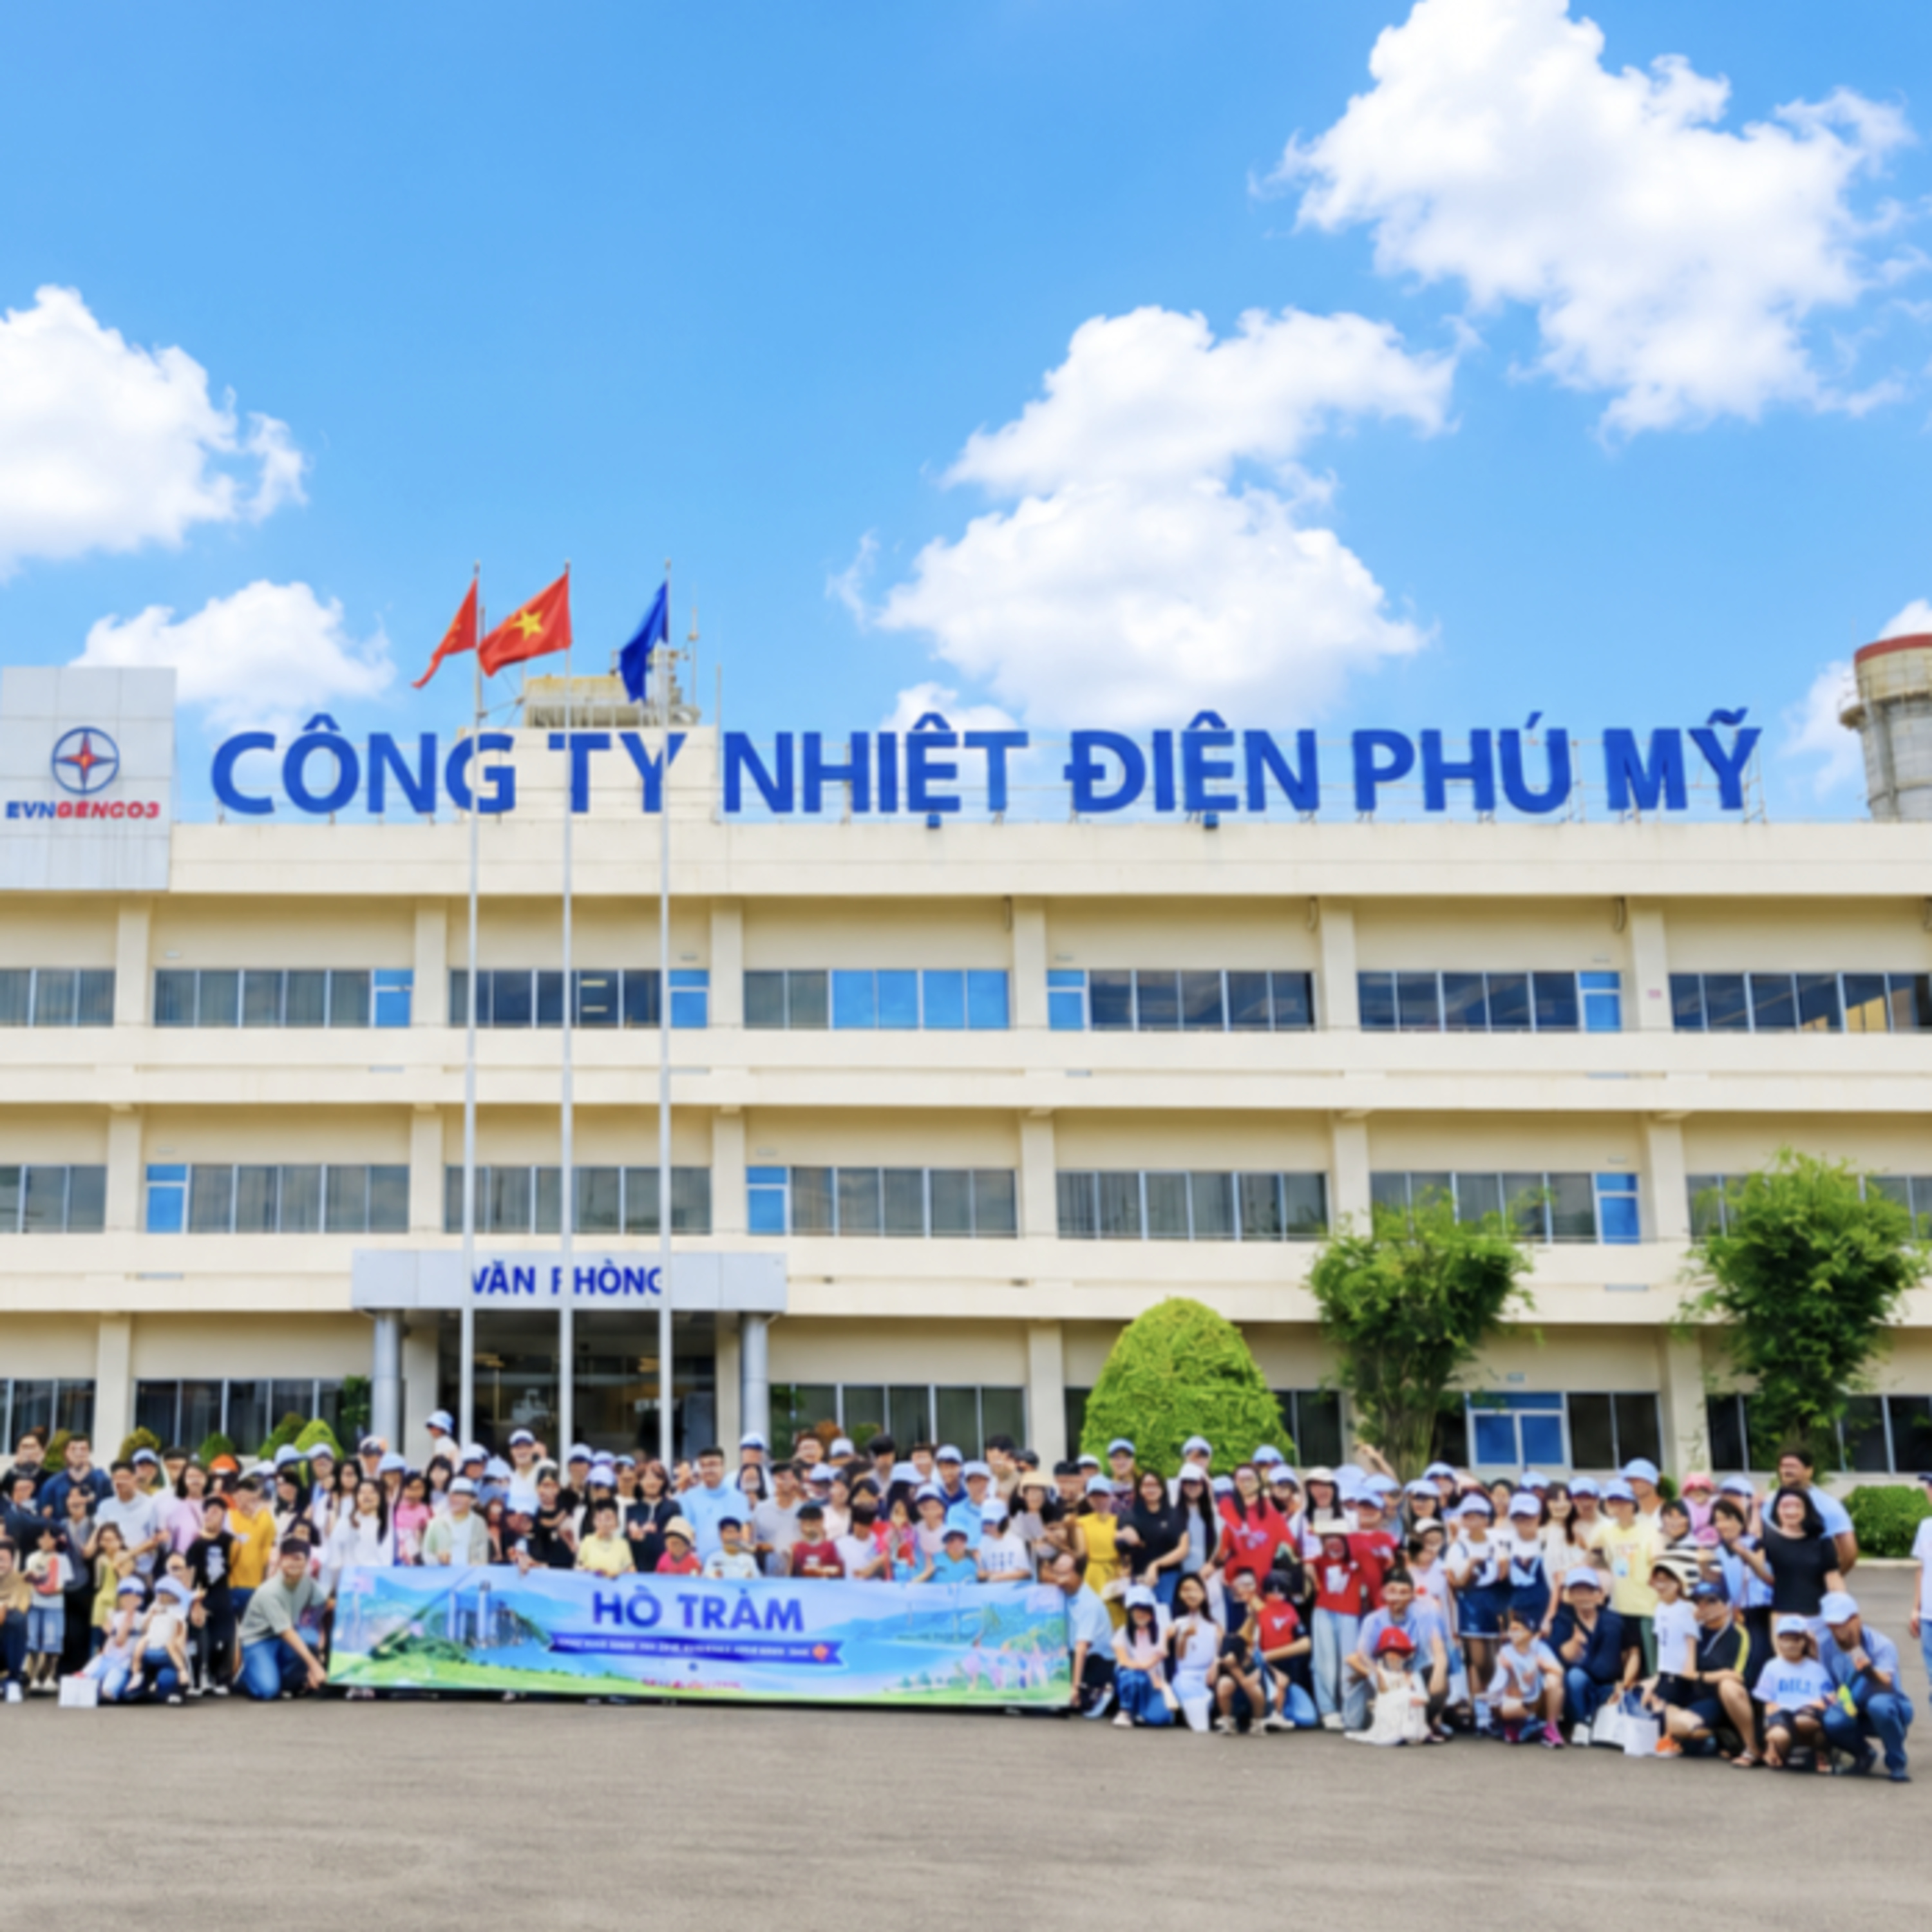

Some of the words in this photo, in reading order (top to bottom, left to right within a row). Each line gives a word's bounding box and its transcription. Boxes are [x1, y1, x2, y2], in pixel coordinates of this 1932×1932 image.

[211, 713, 515, 815] CÔNG
[548, 732, 687, 813] TY
[1351, 710, 1572, 813] PHÚ
[1602, 706, 1763, 811] MỸ
[5, 800, 160, 819] EVNGENCO3
[471, 1259, 536, 1295] VĂN
